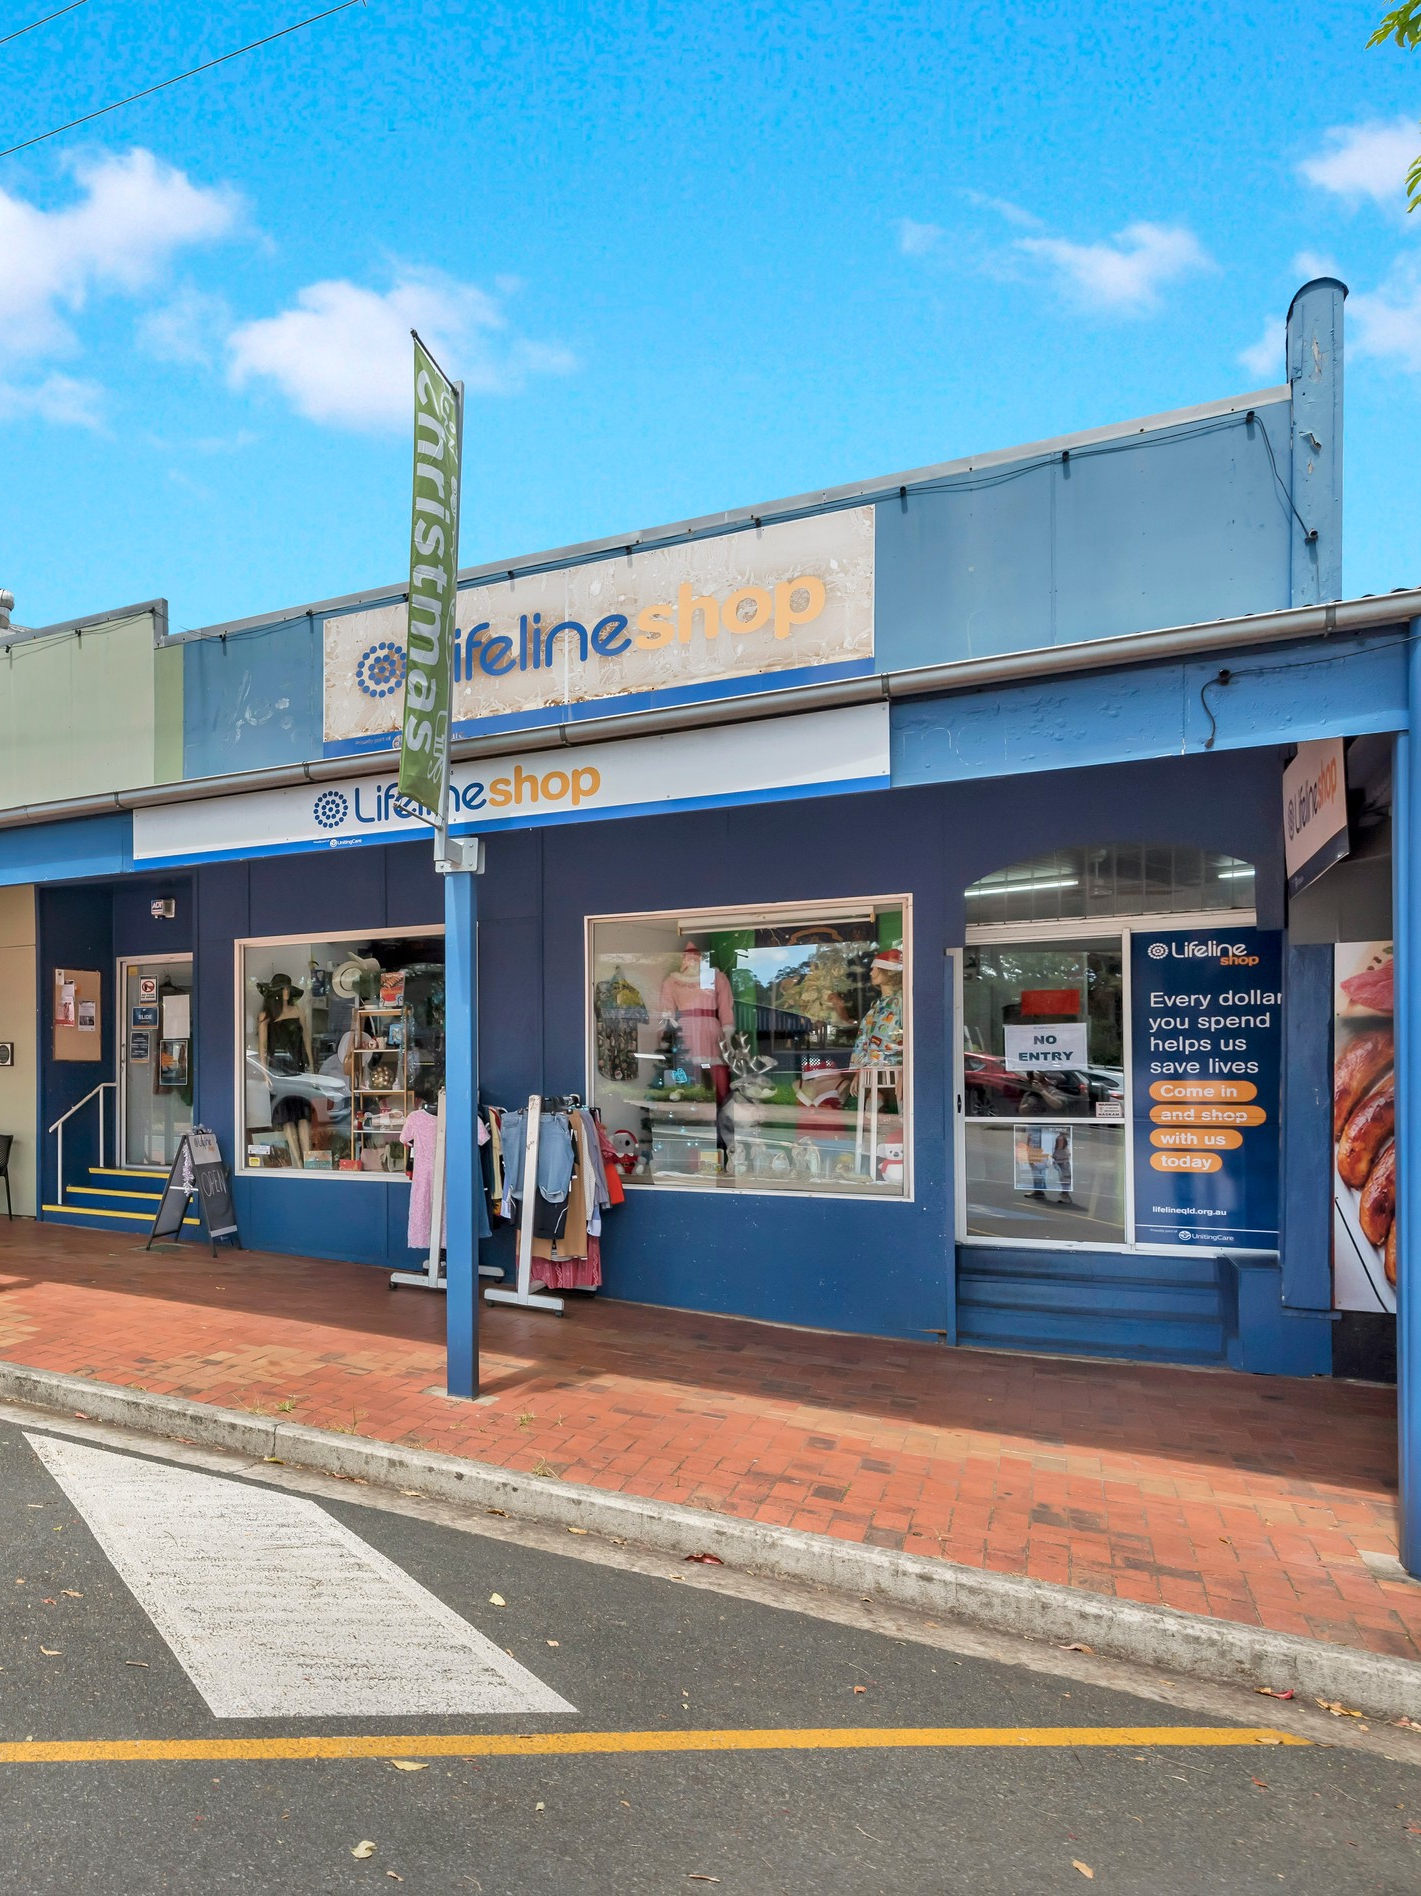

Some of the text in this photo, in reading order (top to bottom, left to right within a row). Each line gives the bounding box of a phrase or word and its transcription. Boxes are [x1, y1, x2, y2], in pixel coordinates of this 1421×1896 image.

[1171, 940, 1248, 958] Lifeline
[1220, 955, 1260, 967] shop
[1150, 989, 1282, 1010] Every dollar
[1149, 1012, 1270, 1033] you spend
[1033, 1035, 1057, 1045] NO
[1150, 1036, 1247, 1055] helps us
[1018, 1051, 1074, 1062] ENTRY
[1150, 1058, 1259, 1074] save lives
[1160, 1084, 1238, 1098] Come in
[1160, 1108, 1248, 1123] and shop
[1160, 1132, 1226, 1145] with us
[1161, 1155, 1212, 1170] today
[200, 1169, 227, 1198] OPEN
[1152, 1206, 1227, 1217] lifelineqld.org.au
[1192, 1233, 1234, 1241] UnitingCare
